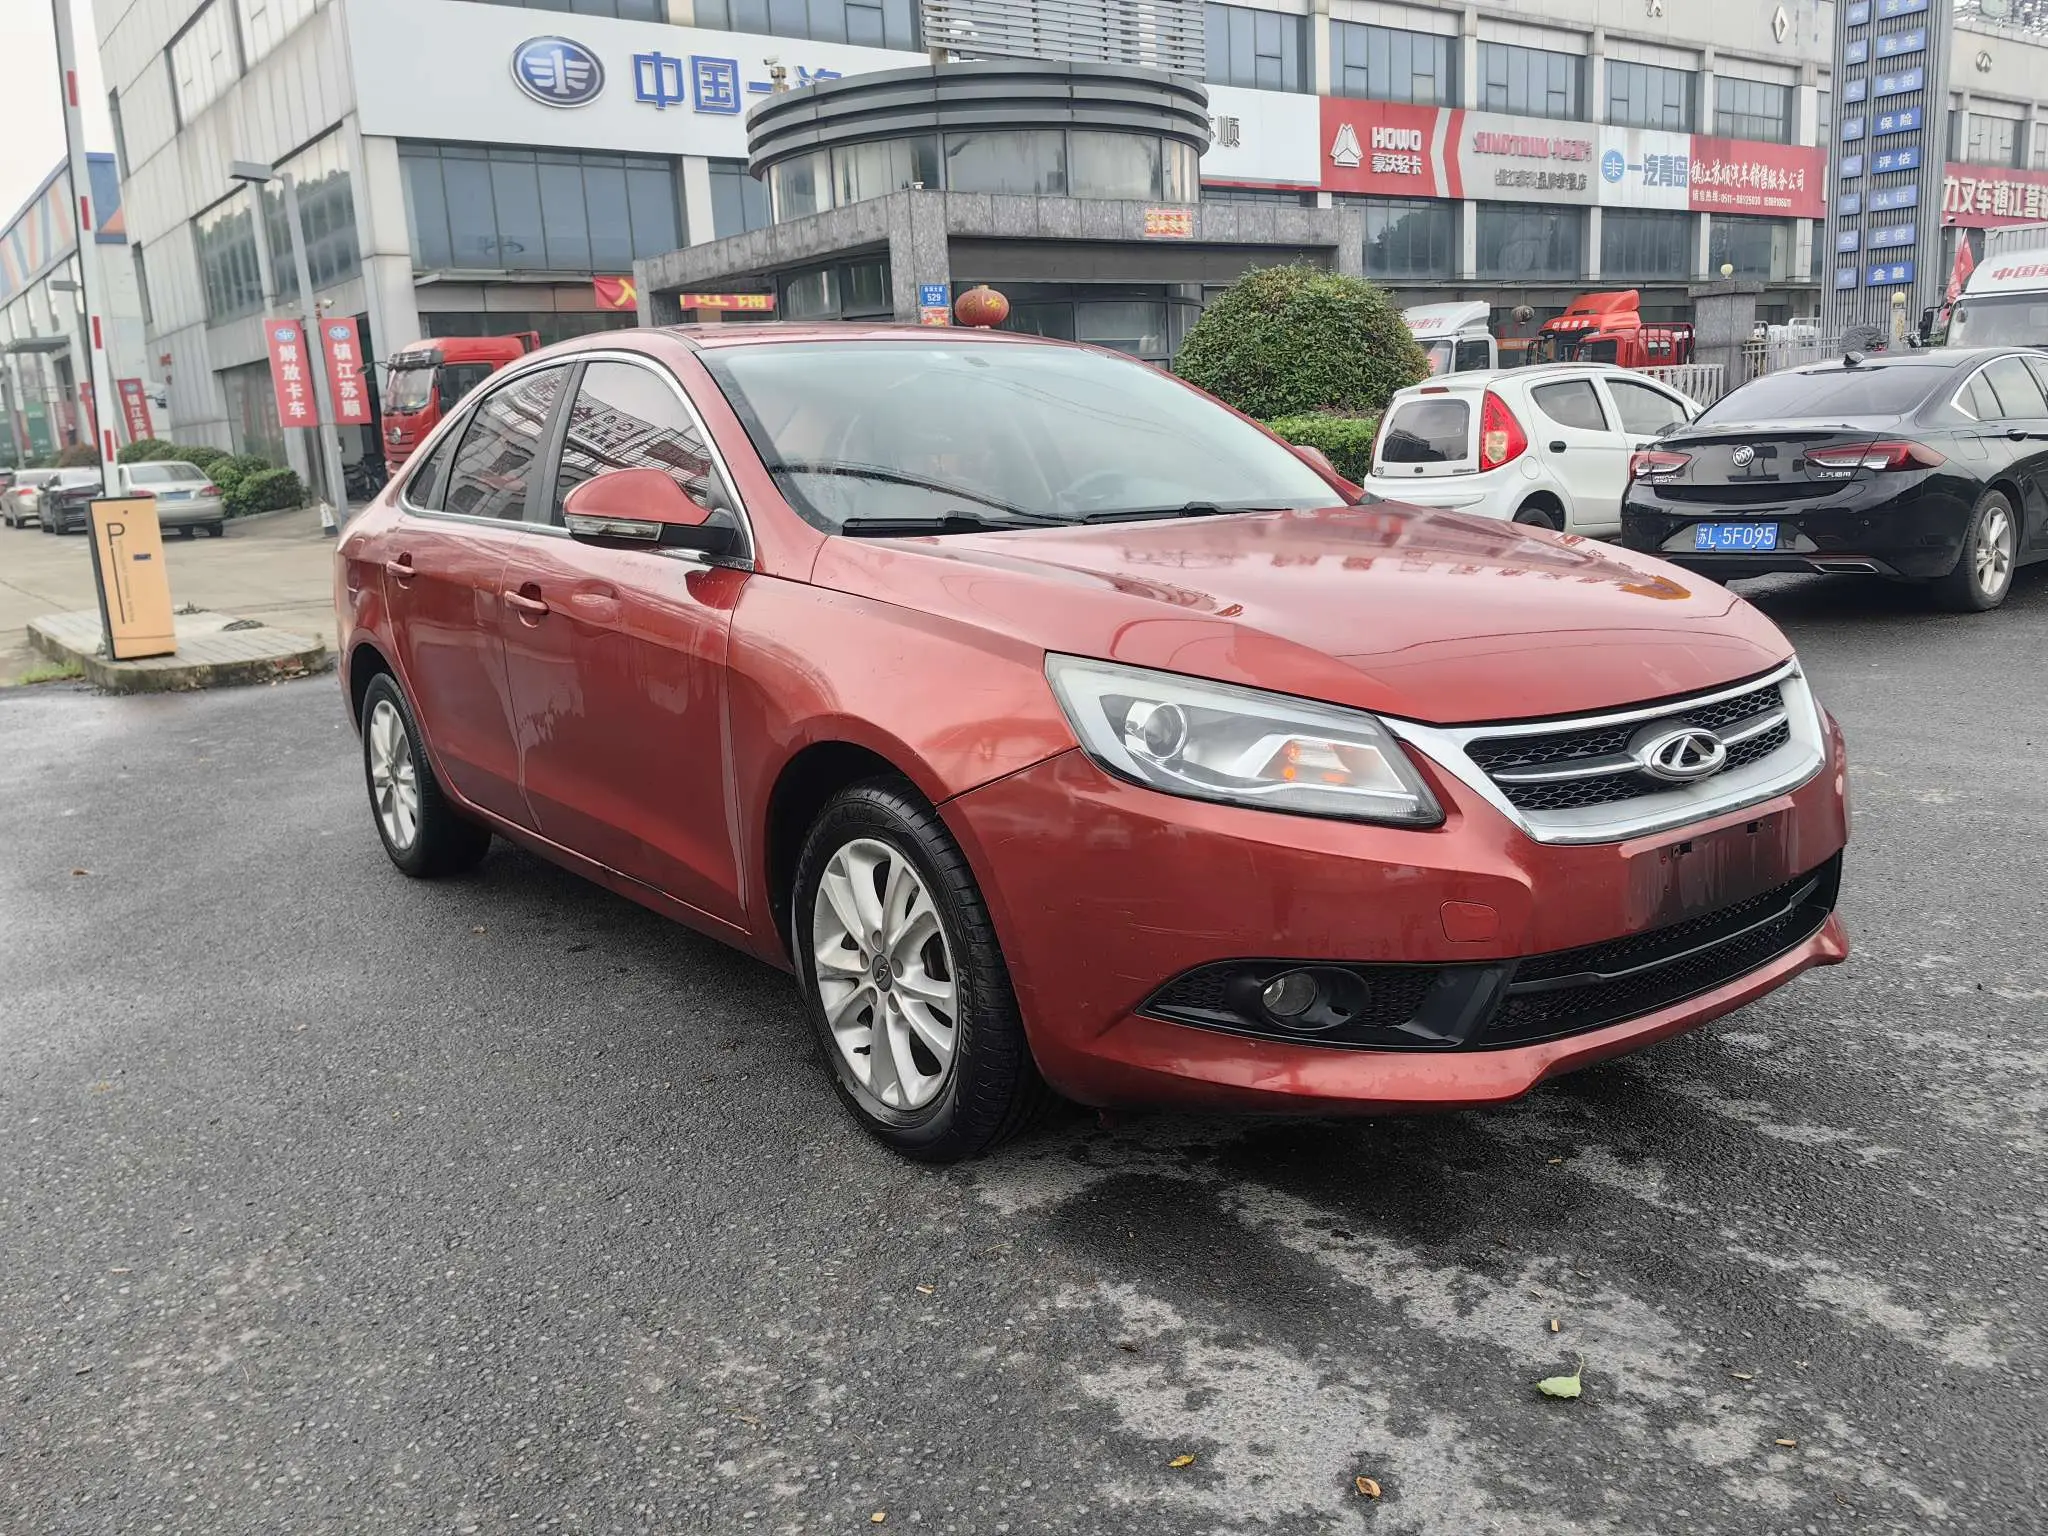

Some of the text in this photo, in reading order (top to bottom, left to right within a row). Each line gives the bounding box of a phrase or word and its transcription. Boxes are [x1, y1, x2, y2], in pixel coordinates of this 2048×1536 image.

[1880, 113, 1913, 130] 保险
[1371, 126, 1422, 151] HOWO
[1371, 153, 1423, 175] 豪沃轻卡
[1627, 153, 1688, 188] 一汽青岛
[1878, 152, 1912, 169] 评估
[1691, 158, 1805, 192] 镇江苏顺汽车销售服务公司
[1876, 191, 1909, 206] 认证
[1872, 266, 1905, 281] 金融
[927, 293, 941, 302] 529
[278, 344, 307, 418] 解放卡车
[333, 343, 362, 417] 镇江苏顺
[107, 522, 125, 546] P
